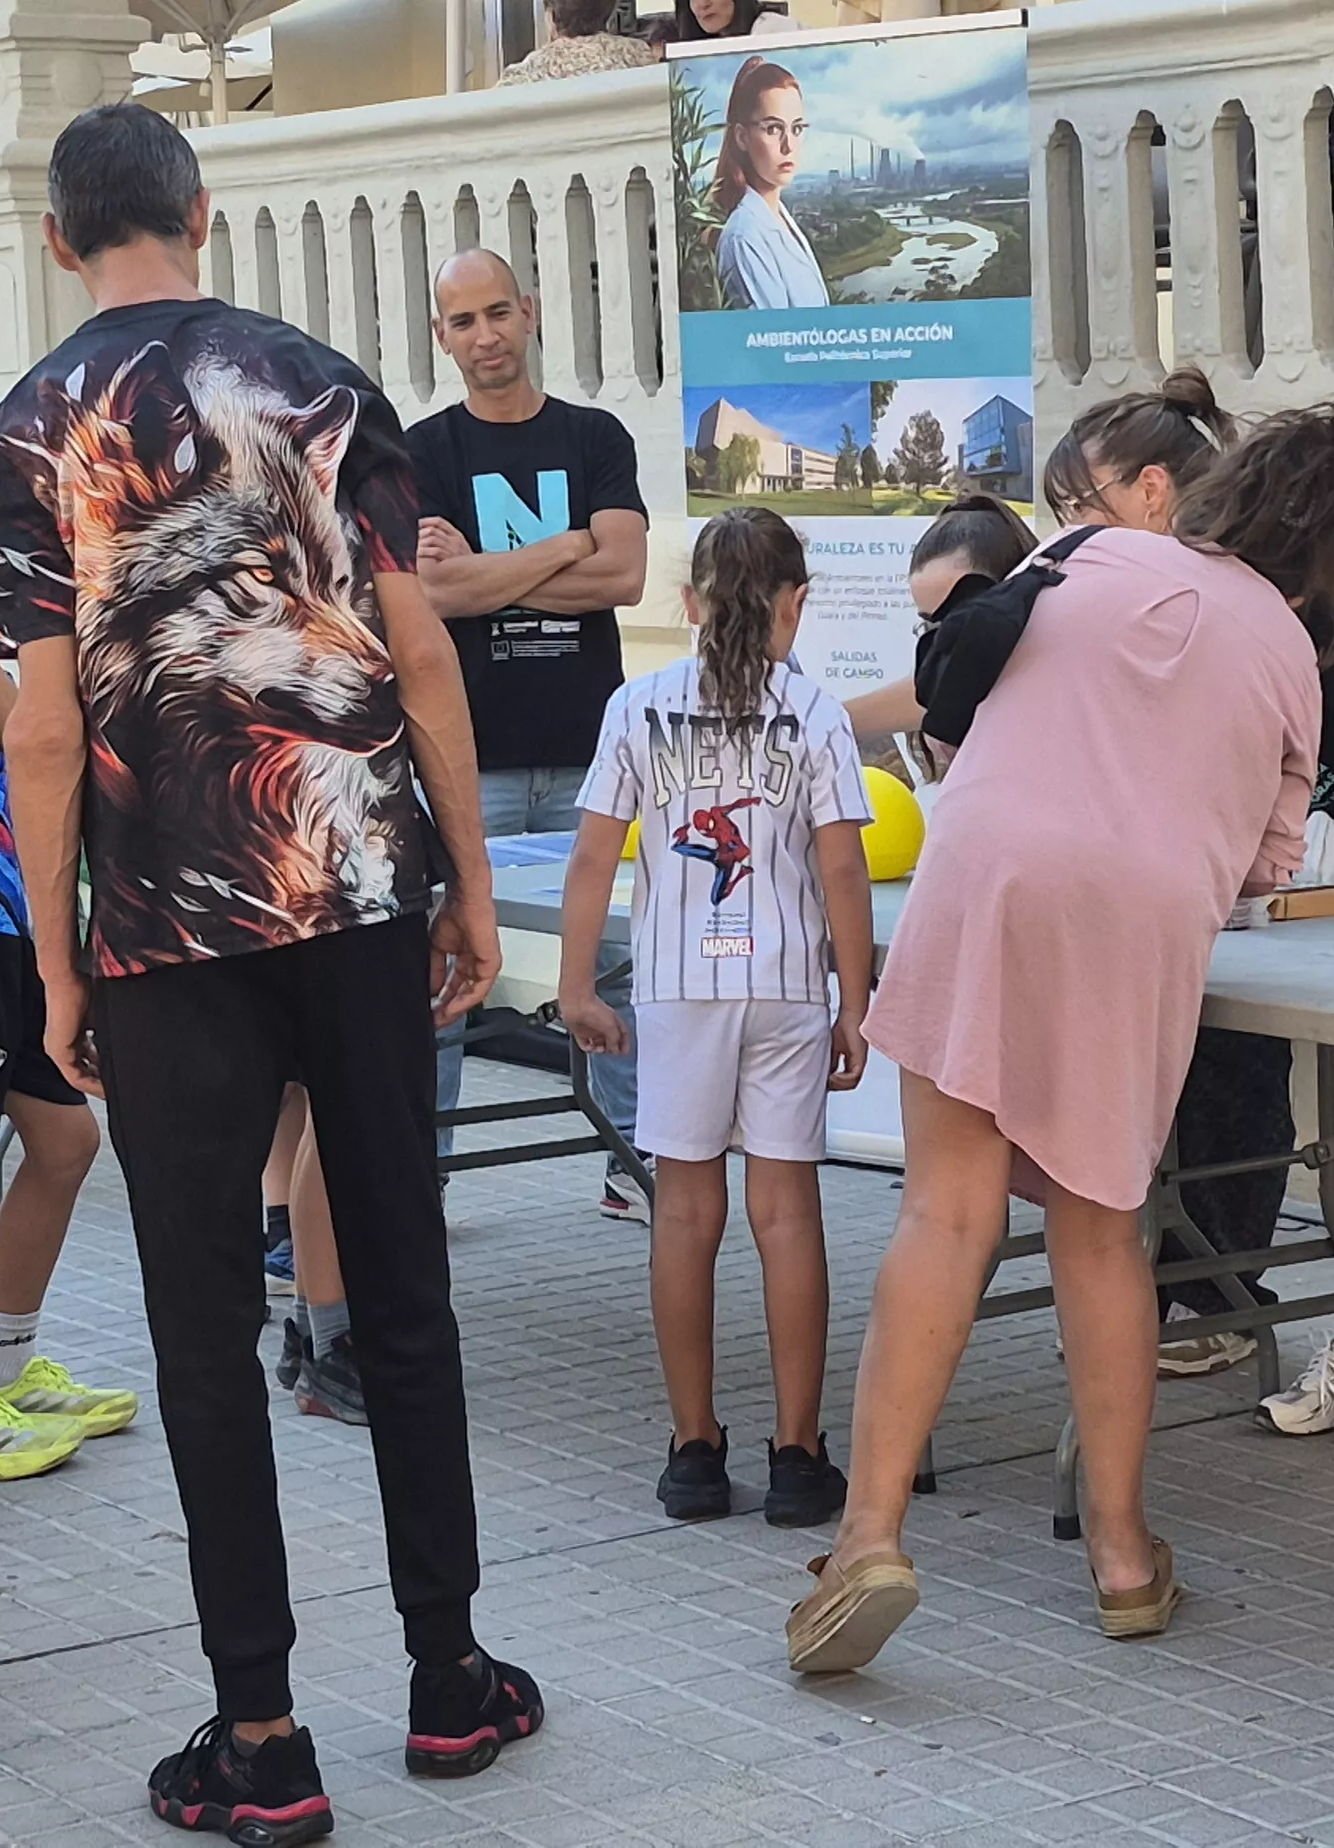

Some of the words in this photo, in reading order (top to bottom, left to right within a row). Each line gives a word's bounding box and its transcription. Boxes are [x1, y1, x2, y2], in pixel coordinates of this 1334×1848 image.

[747, 328, 867, 348] AMBIENTÓLOGAS
[871, 327, 891, 343] EN
[894, 322, 953, 342] ACCIÓN
[807, 542, 864, 555] URALEZA
[869, 542, 885, 555] ES
[888, 542, 904, 555] TU
[831, 650, 877, 662] SALIDAS
[825, 667, 839, 677] DE
[842, 668, 884, 679] CAMPO
[644, 706, 800, 810] NETS
[701, 937, 753, 957] MARVEL
